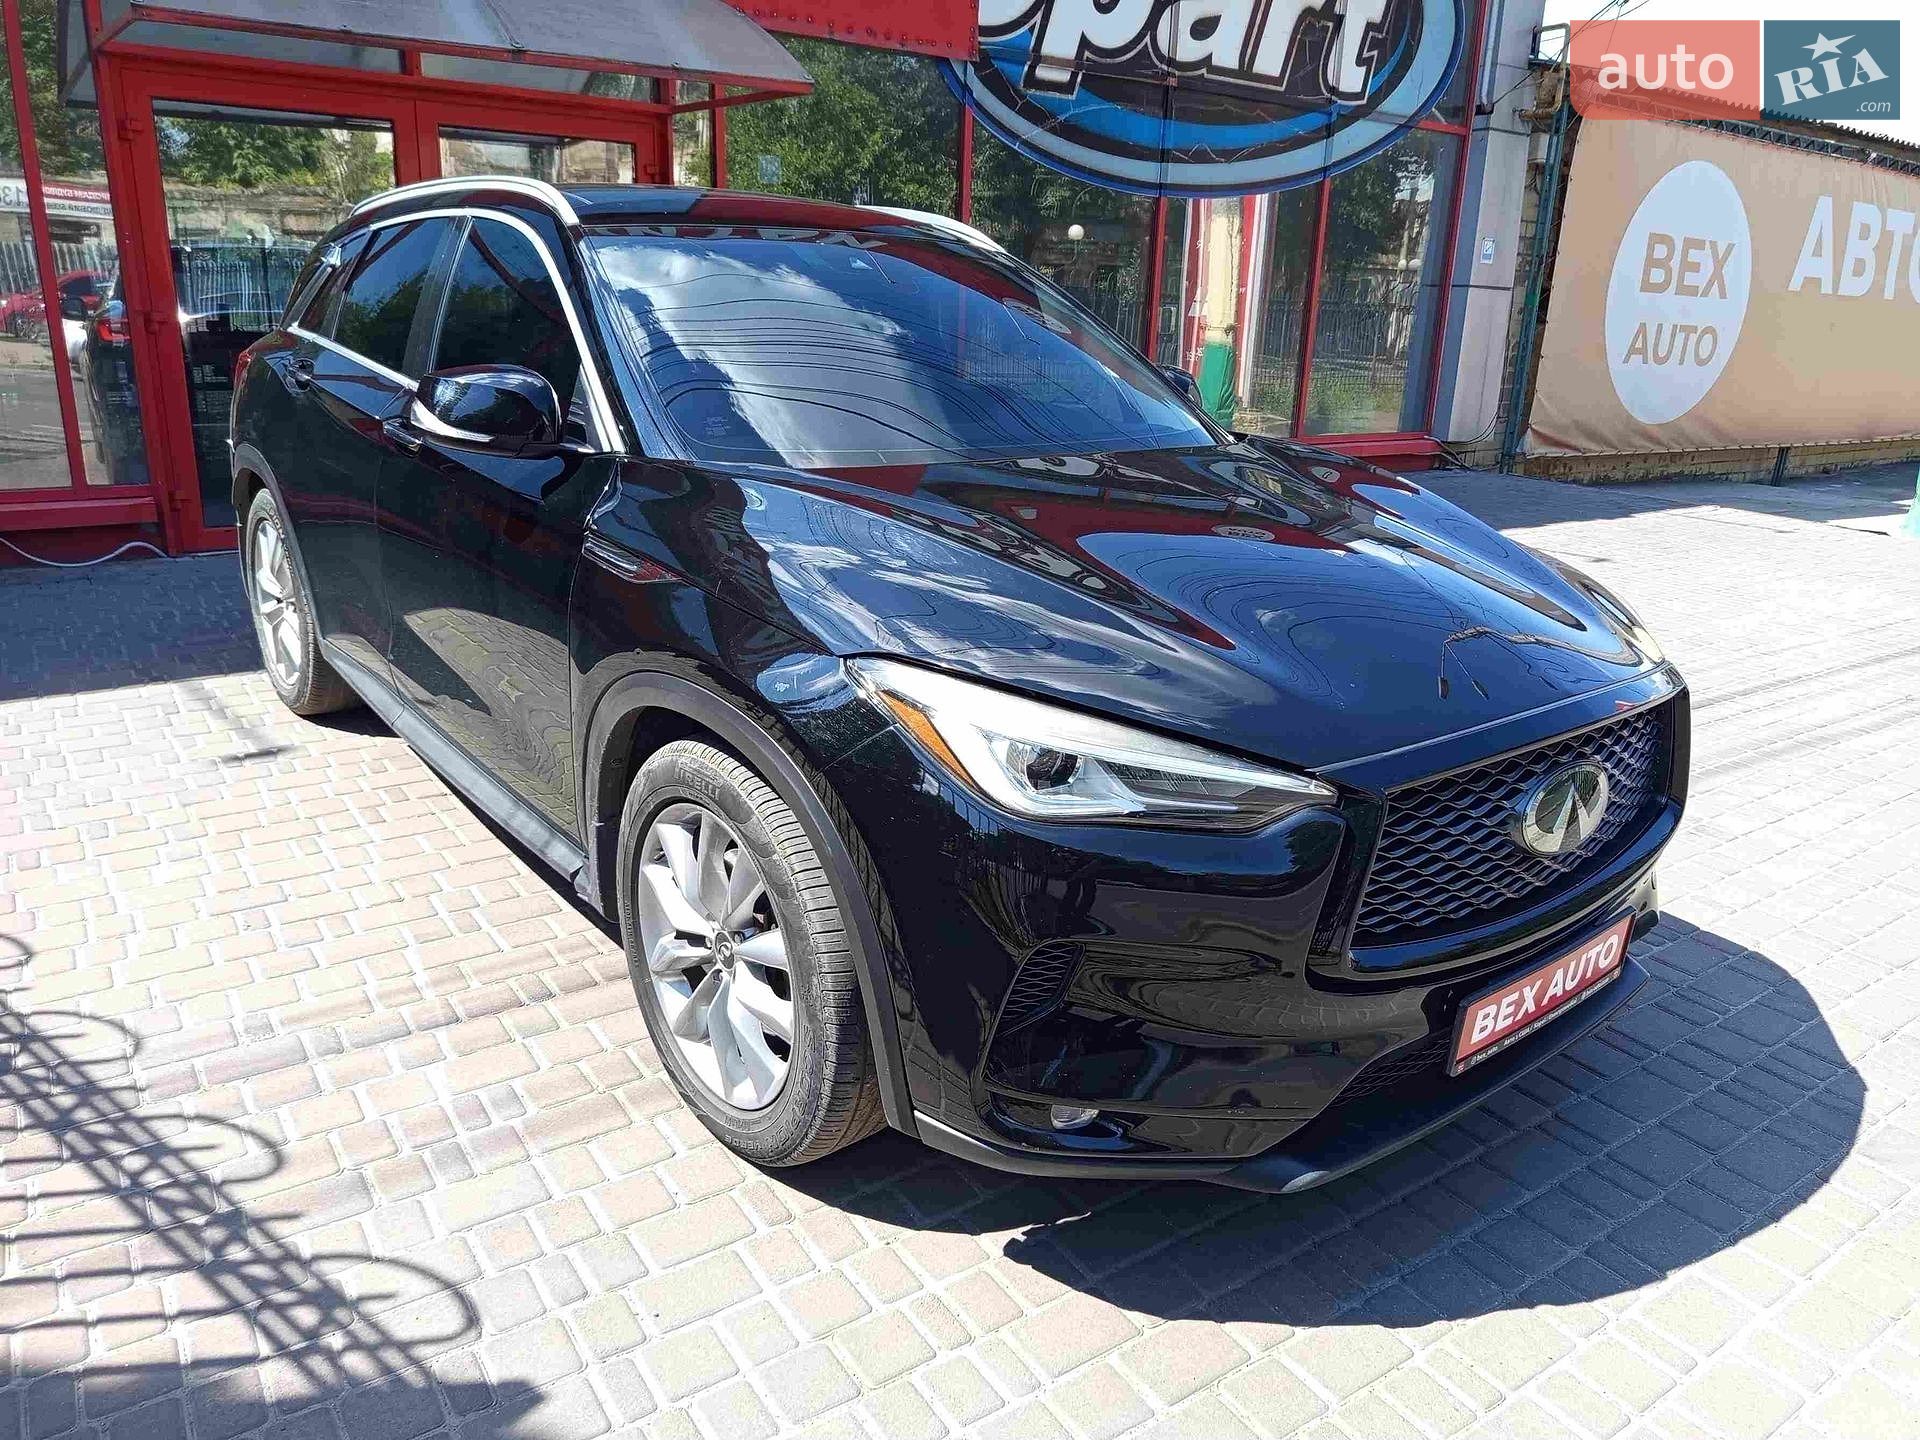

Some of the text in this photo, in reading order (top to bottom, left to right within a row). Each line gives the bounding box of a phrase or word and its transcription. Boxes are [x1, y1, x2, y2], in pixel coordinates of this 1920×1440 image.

[1639, 231, 1737, 300] BEX
[1622, 322, 1718, 367] AUTO
[1470, 934, 1619, 1045] BEX AUTO
